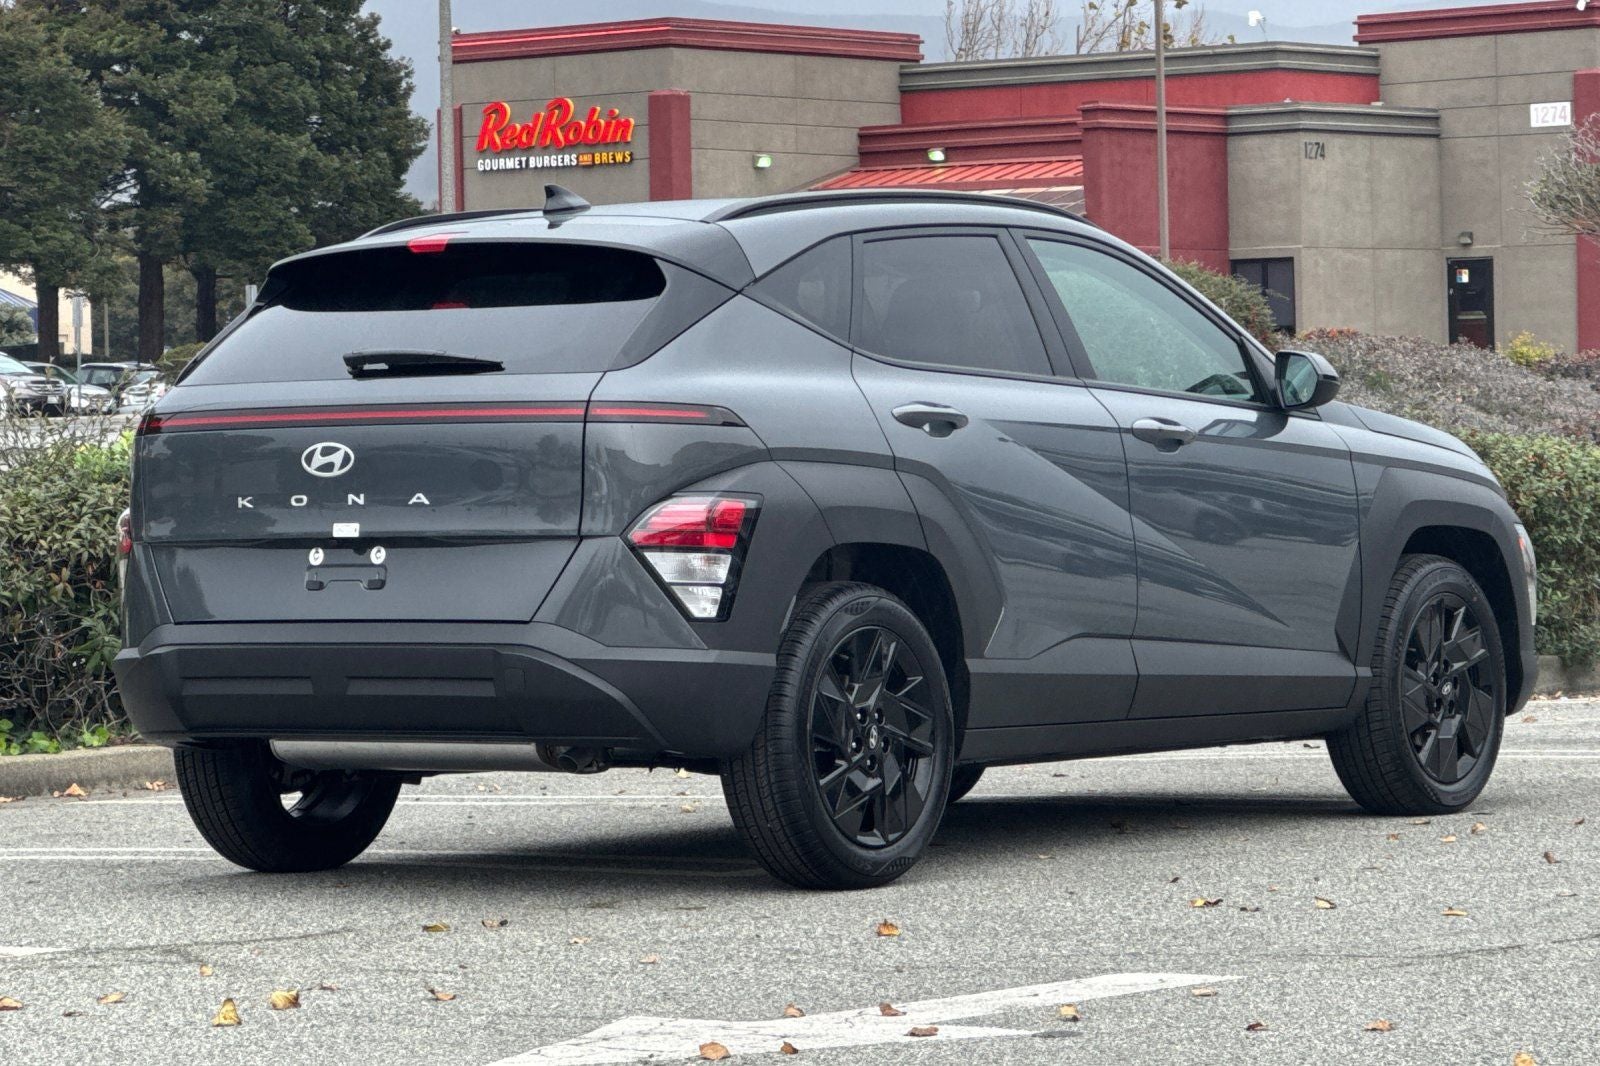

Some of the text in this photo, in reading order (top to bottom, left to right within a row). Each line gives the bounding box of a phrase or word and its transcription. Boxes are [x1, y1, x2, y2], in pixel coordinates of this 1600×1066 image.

[1533, 105, 1568, 124] 1274
[1304, 141, 1325, 160] 1274
[477, 151, 632, 171] GOURMET BURGERS AND BREWS
